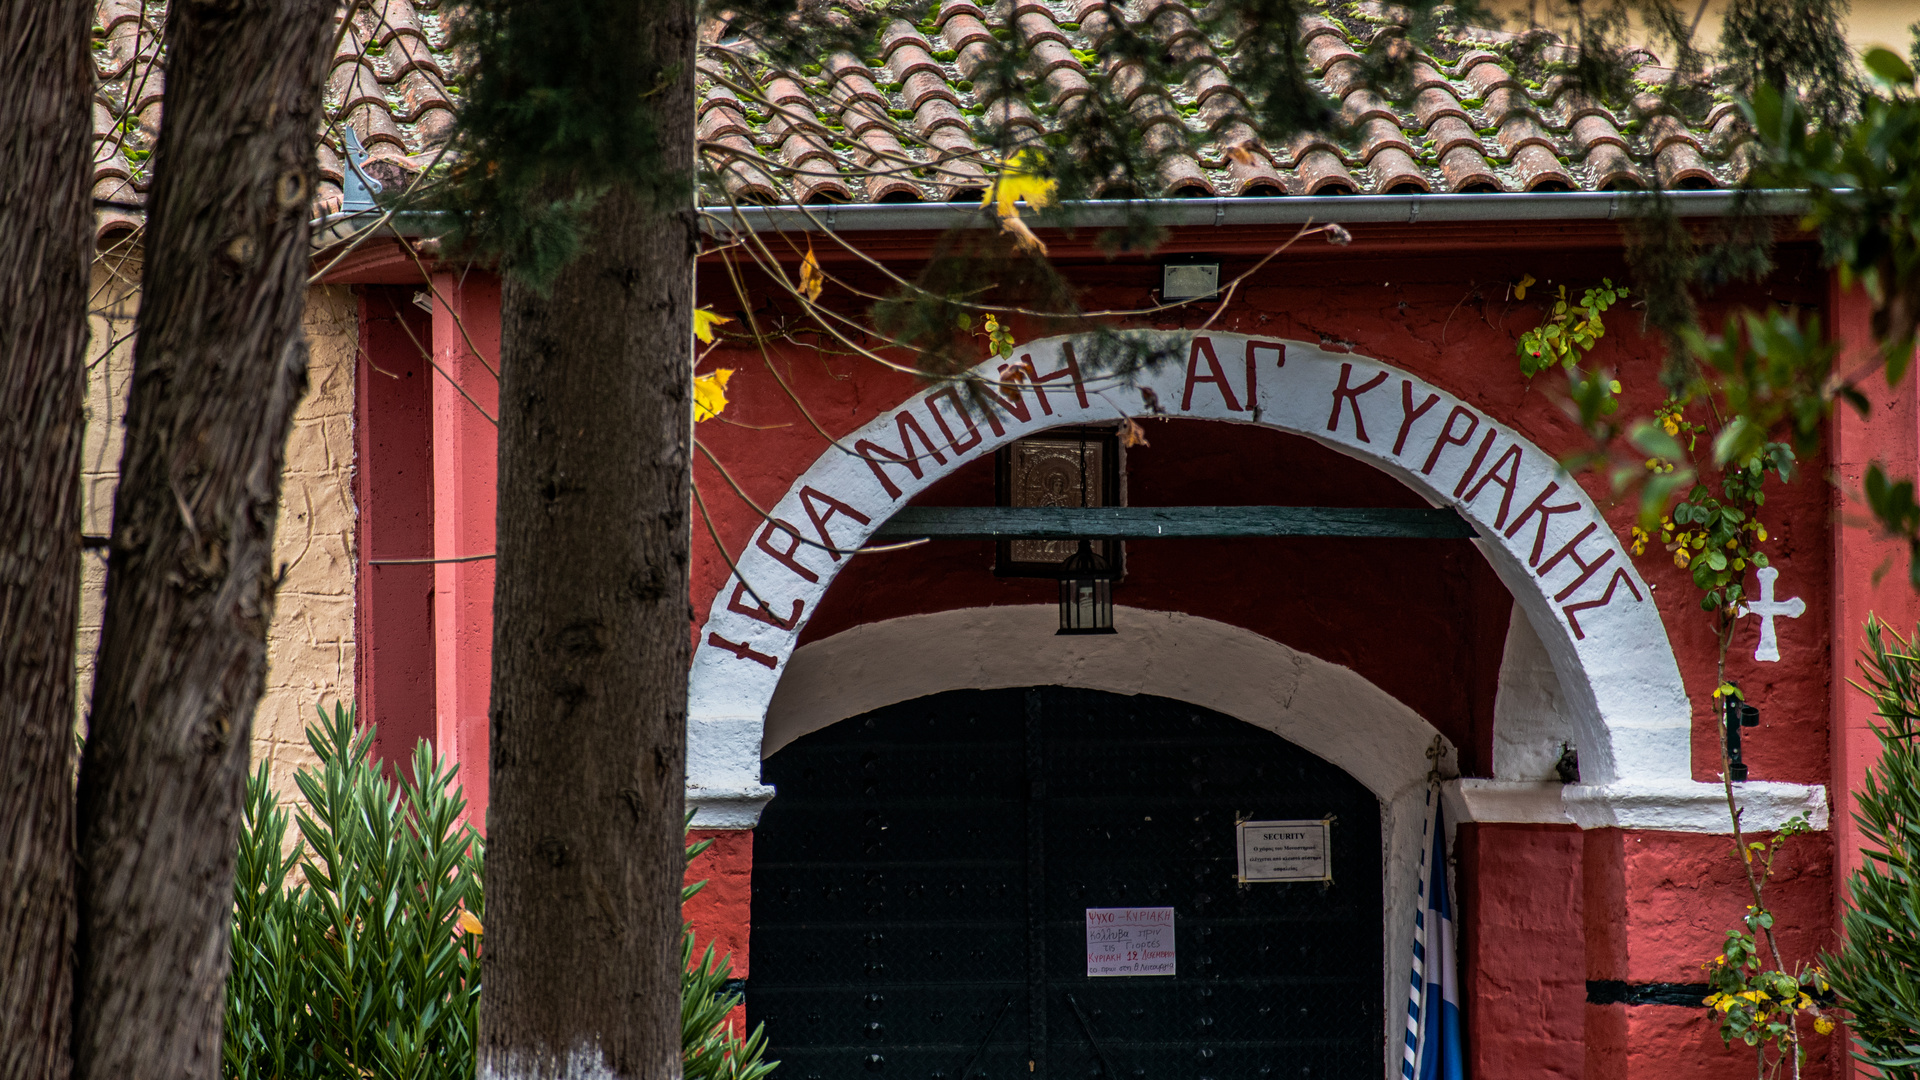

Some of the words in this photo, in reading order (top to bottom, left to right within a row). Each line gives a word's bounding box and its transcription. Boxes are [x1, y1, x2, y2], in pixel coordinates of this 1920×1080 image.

[707, 485, 872, 671] ΙΕΡΑ
[854, 341, 1090, 502] ΜΟΝΗ
[1327, 362, 1643, 641] ΚΥΡΙΑΚΗΣ
[1126, 950, 1139, 961] 12
